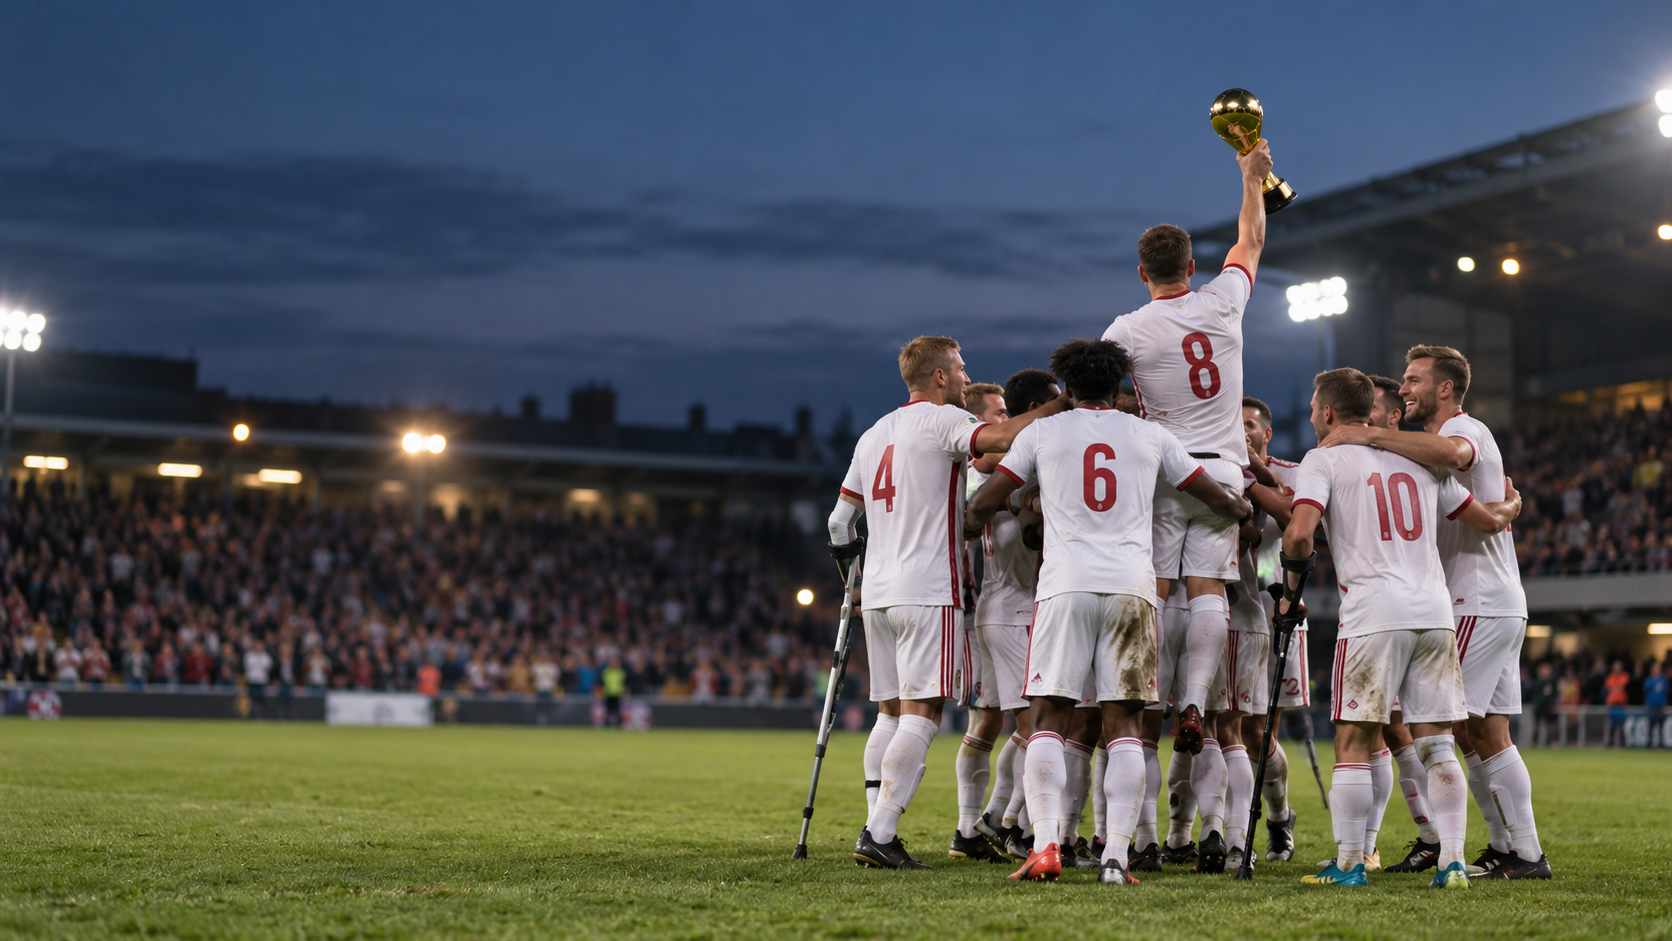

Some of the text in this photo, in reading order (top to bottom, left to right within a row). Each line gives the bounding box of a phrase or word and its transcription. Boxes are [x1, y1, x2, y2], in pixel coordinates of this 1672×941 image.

[1181, 331, 1221, 400] 8
[872, 443, 896, 513] 4
[1082, 442, 1117, 513] 6
[1366, 471, 1423, 542] 10
